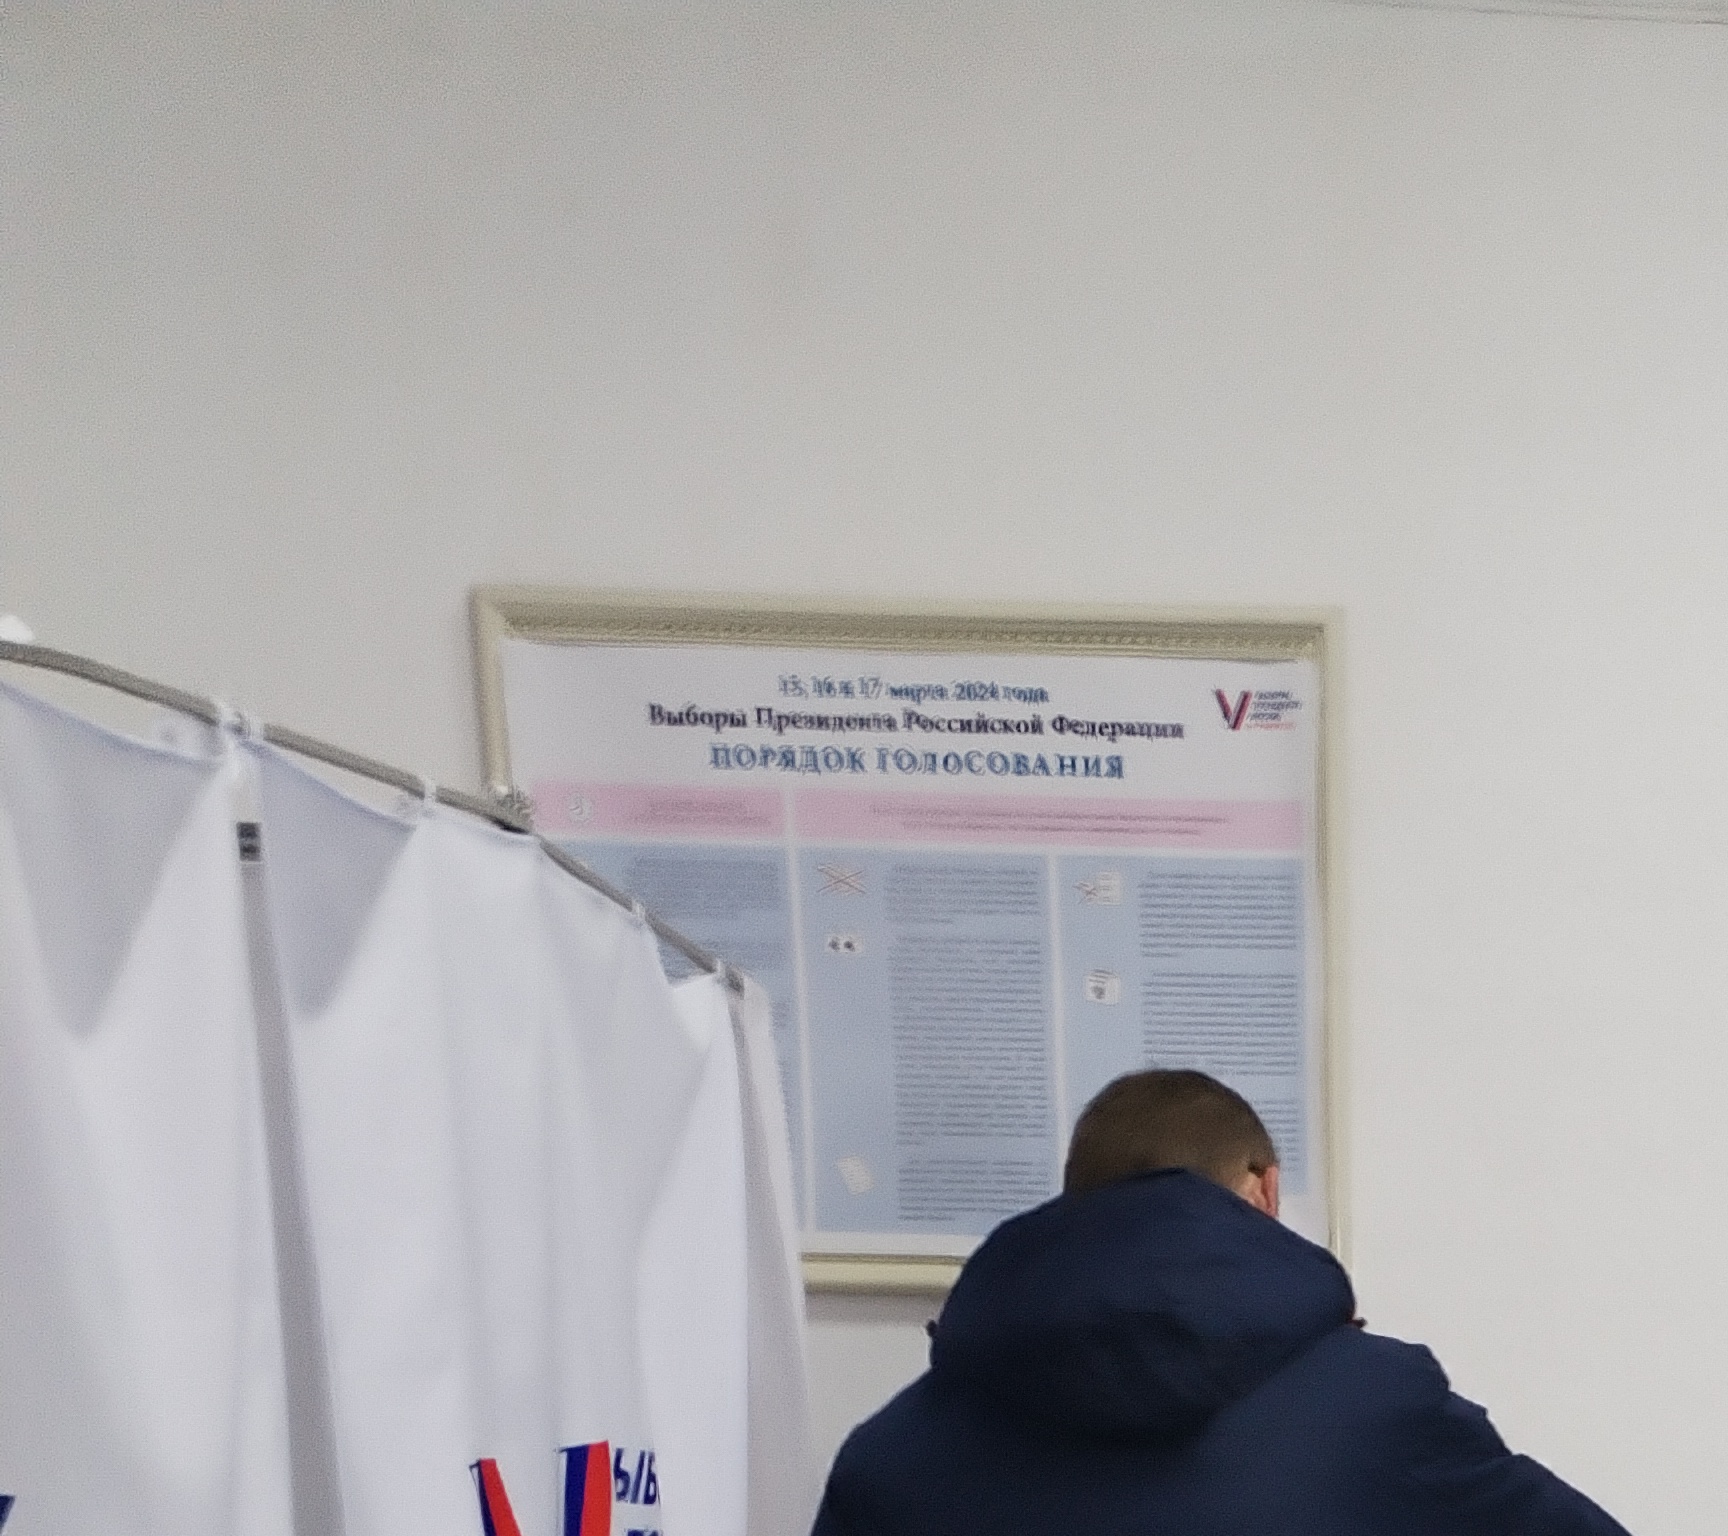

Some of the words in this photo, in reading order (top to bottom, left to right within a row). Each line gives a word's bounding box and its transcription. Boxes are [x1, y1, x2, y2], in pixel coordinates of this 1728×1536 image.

[648, 702, 747, 733] Выборы
[754, 706, 898, 735] Президента
[902, 707, 1043, 735] Российской
[1050, 714, 1184, 742] Федерации
[710, 743, 866, 774] ПОРЯДОК
[876, 744, 1124, 778] ГОЛОСОВАНИЯ
